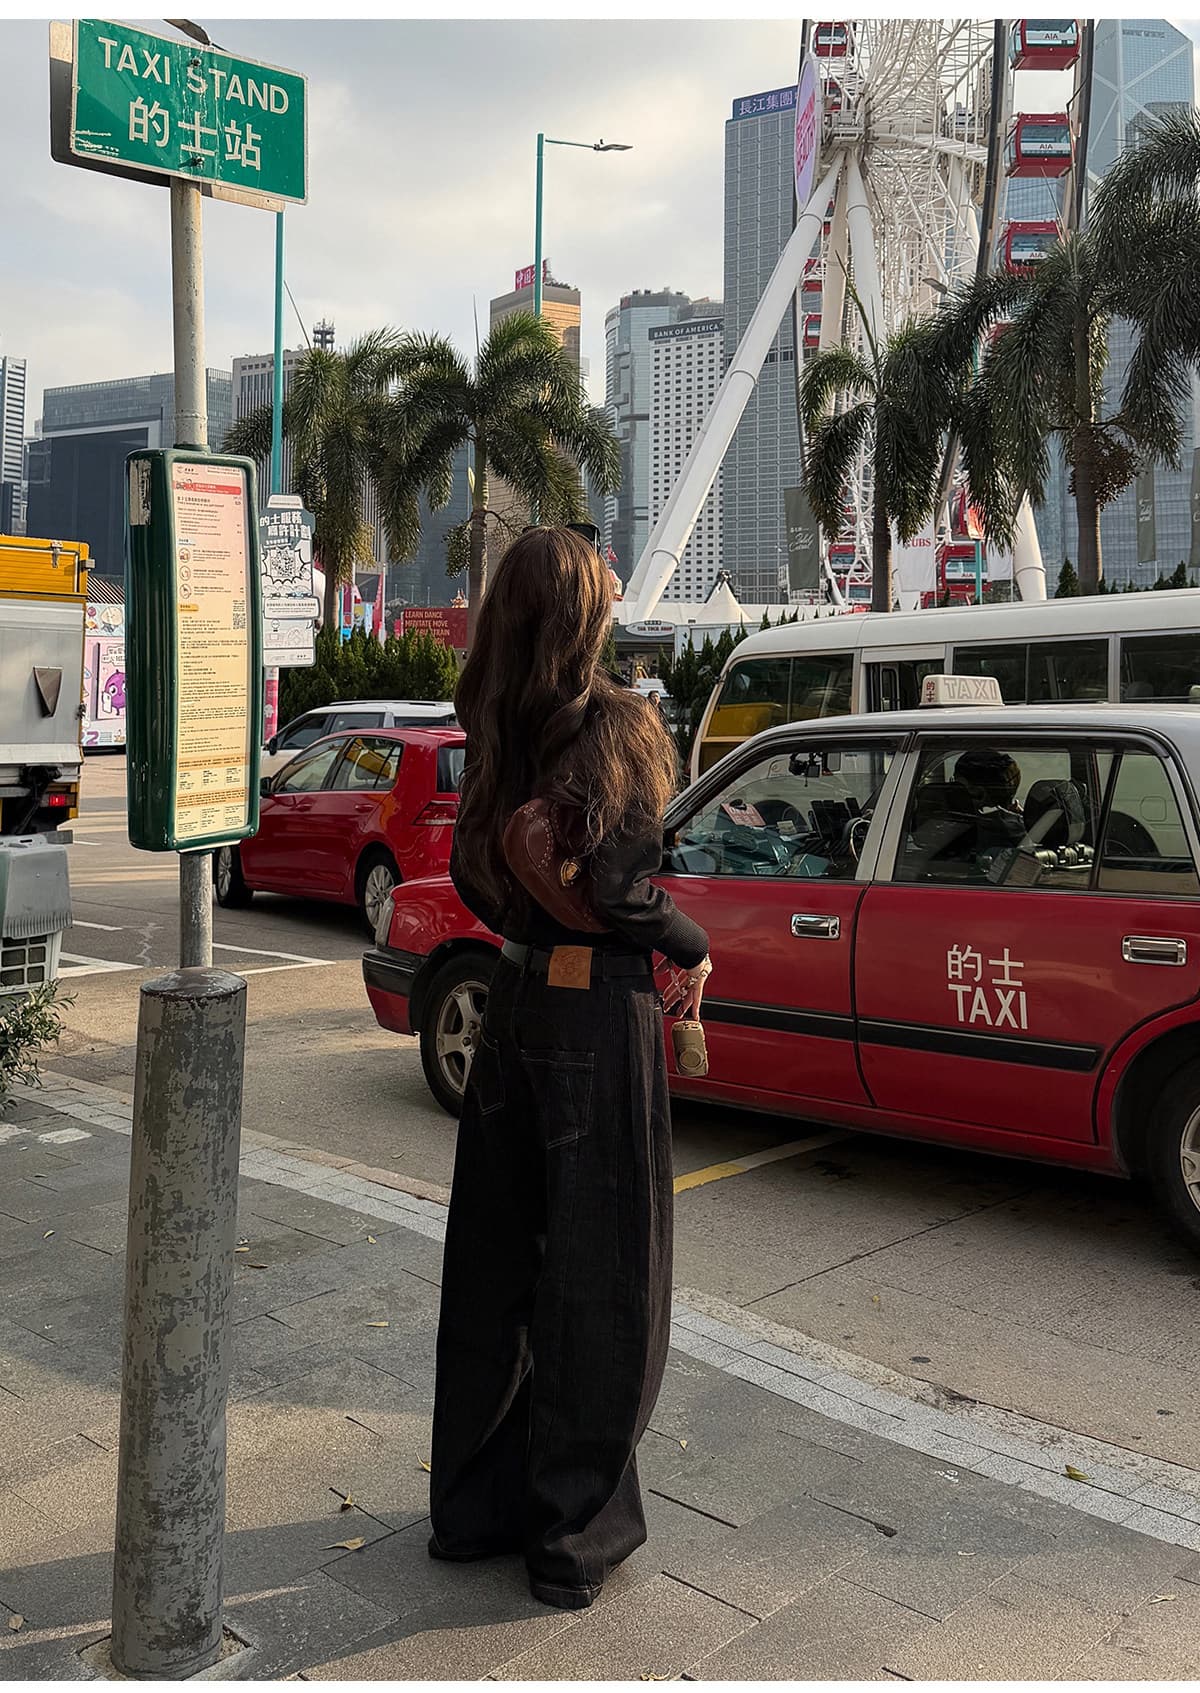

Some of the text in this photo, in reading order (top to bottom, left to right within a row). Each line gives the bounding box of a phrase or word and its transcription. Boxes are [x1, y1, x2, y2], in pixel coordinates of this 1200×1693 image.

[1044, 32, 1058, 40] AIA
[98, 36, 289, 115] TAXI STAND
[128, 96, 262, 171] 的士站
[654, 329, 674, 338] BANK
[685, 323, 719, 335] AMERICA
[259, 510, 303, 527] 的士服務
[911, 538, 932, 548] UBS
[405, 611, 443, 619] LEARN DANCE
[432, 620, 449, 628] MOVE
[925, 681, 936, 702] 的士
[944, 679, 998, 700] TAXI
[947, 944, 1025, 987] 的士
[948, 983, 1028, 1030] TAXI
